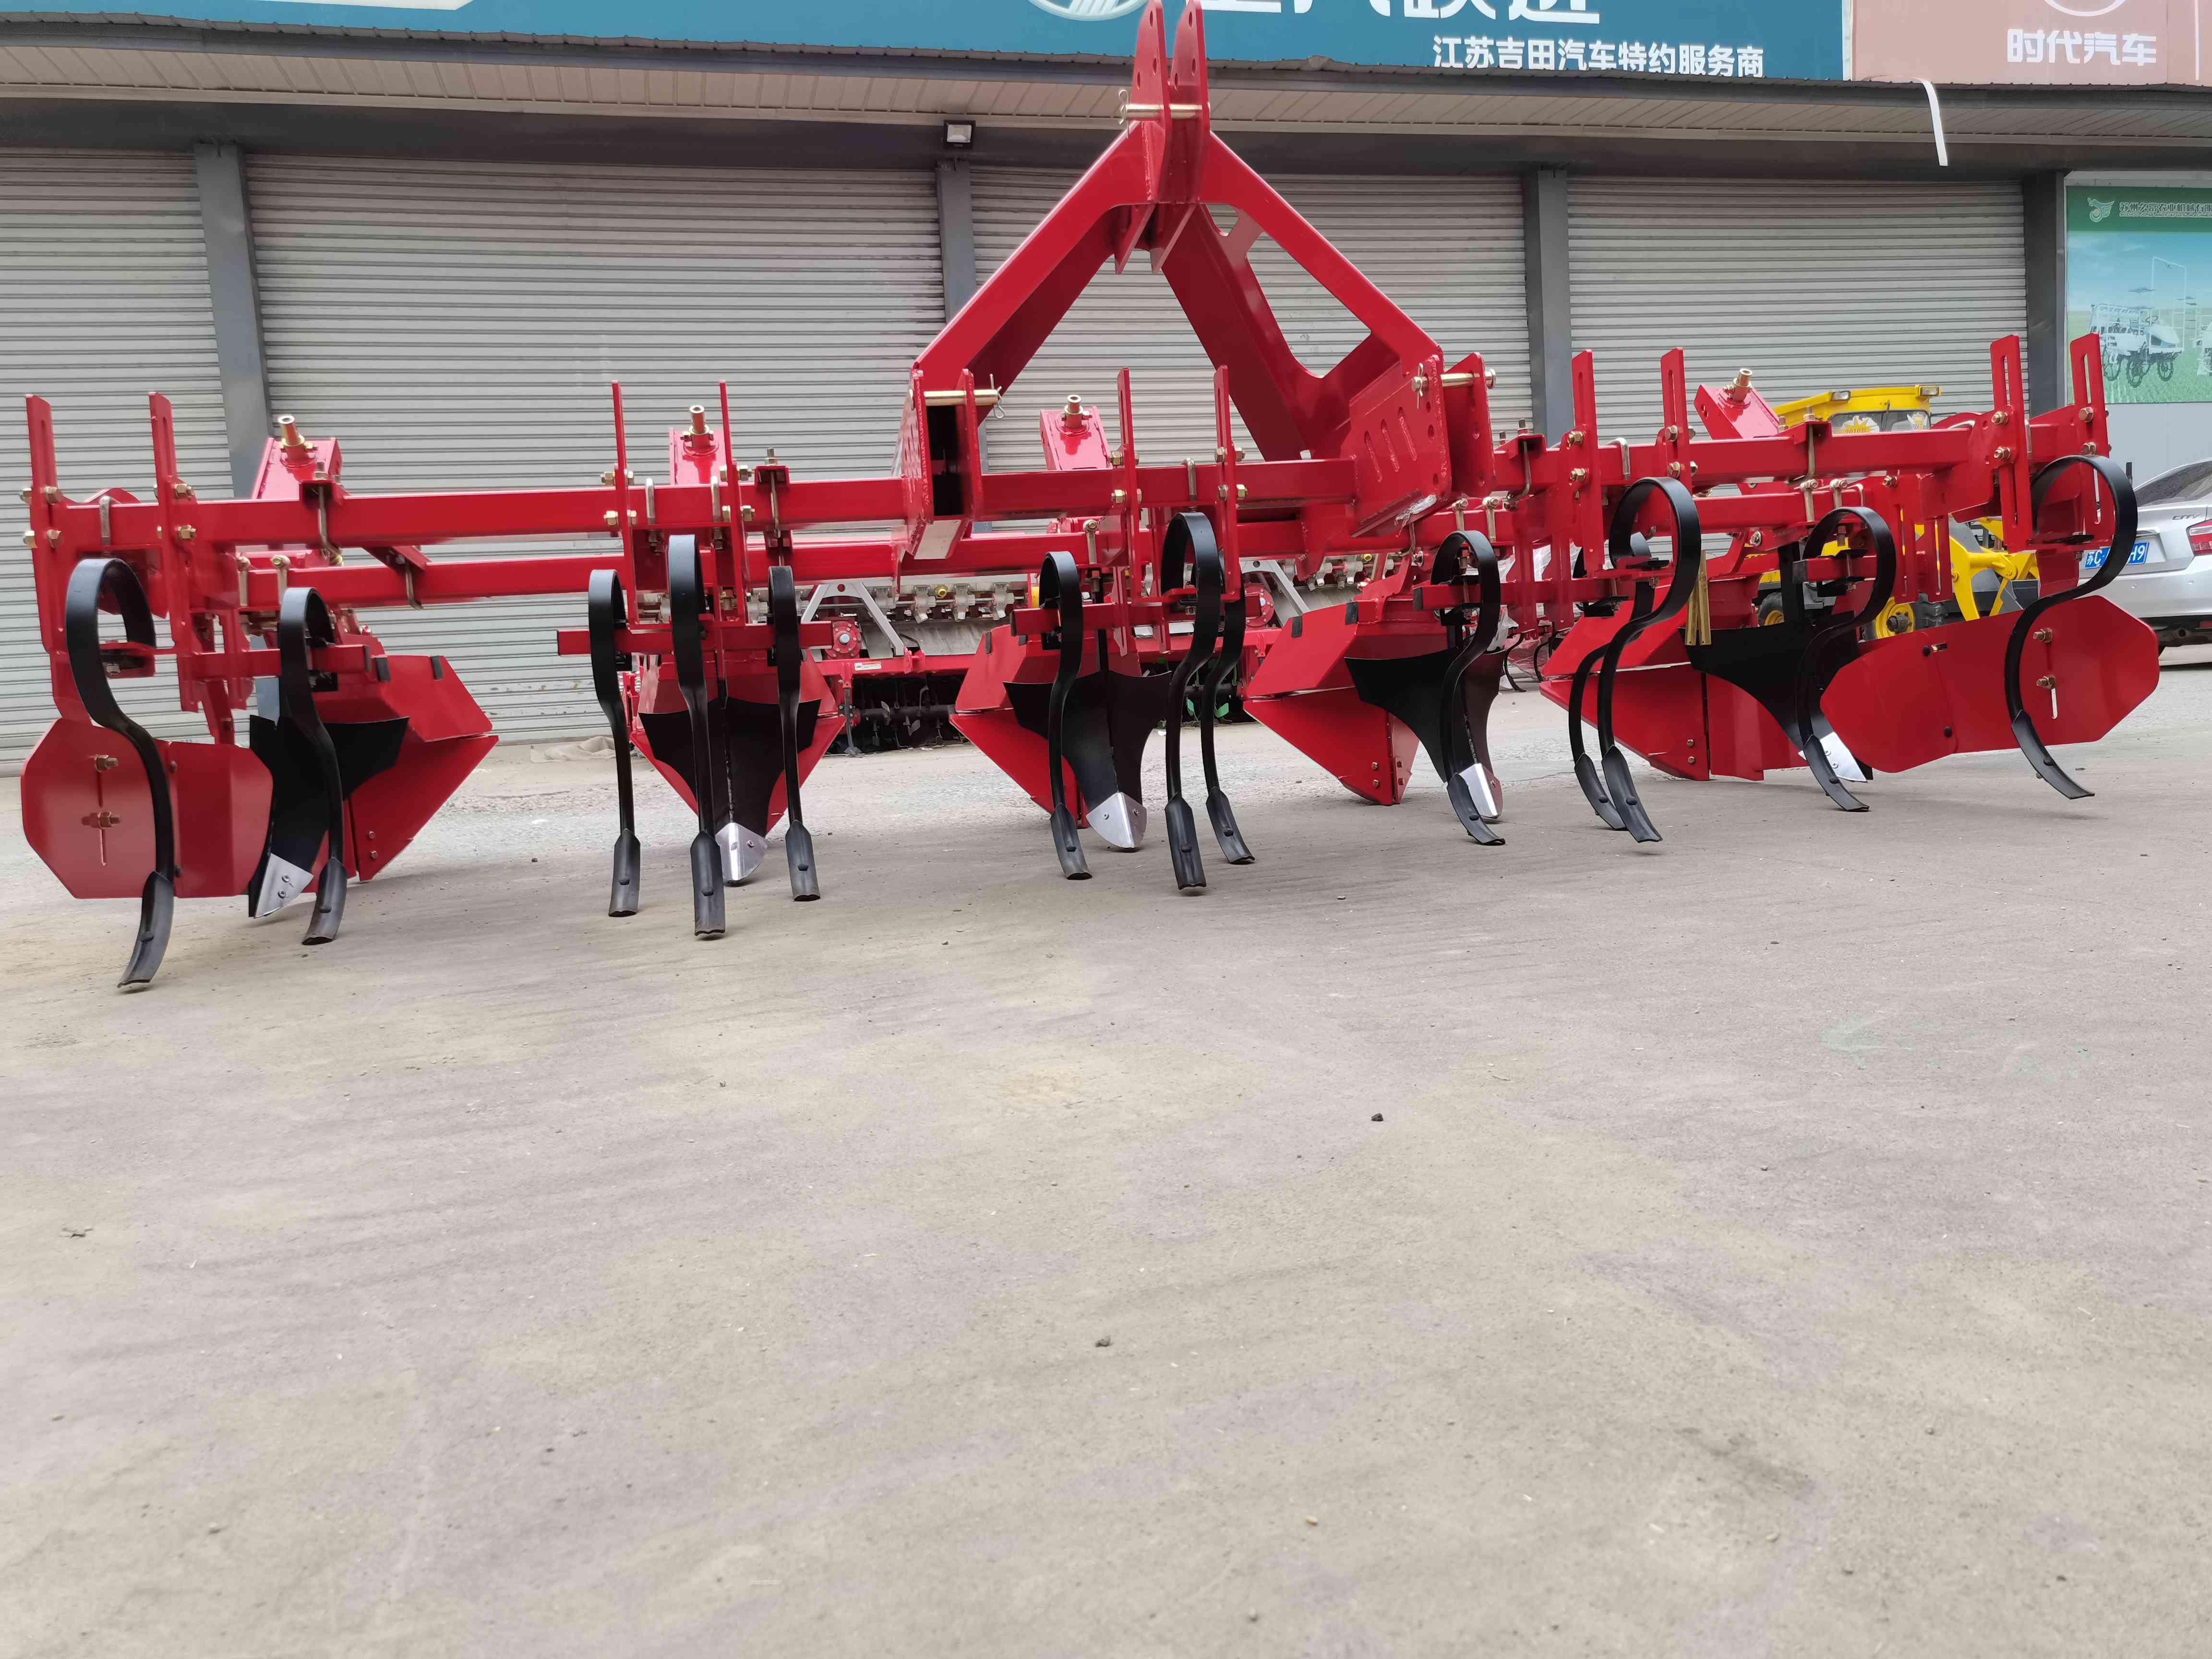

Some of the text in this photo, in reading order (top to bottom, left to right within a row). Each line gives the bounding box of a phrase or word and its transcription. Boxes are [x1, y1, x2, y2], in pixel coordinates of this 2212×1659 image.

[1432, 35, 1764, 78] 江苏吉田汽车特约服务商
[2007, 29, 2157, 66] 时代汽车
